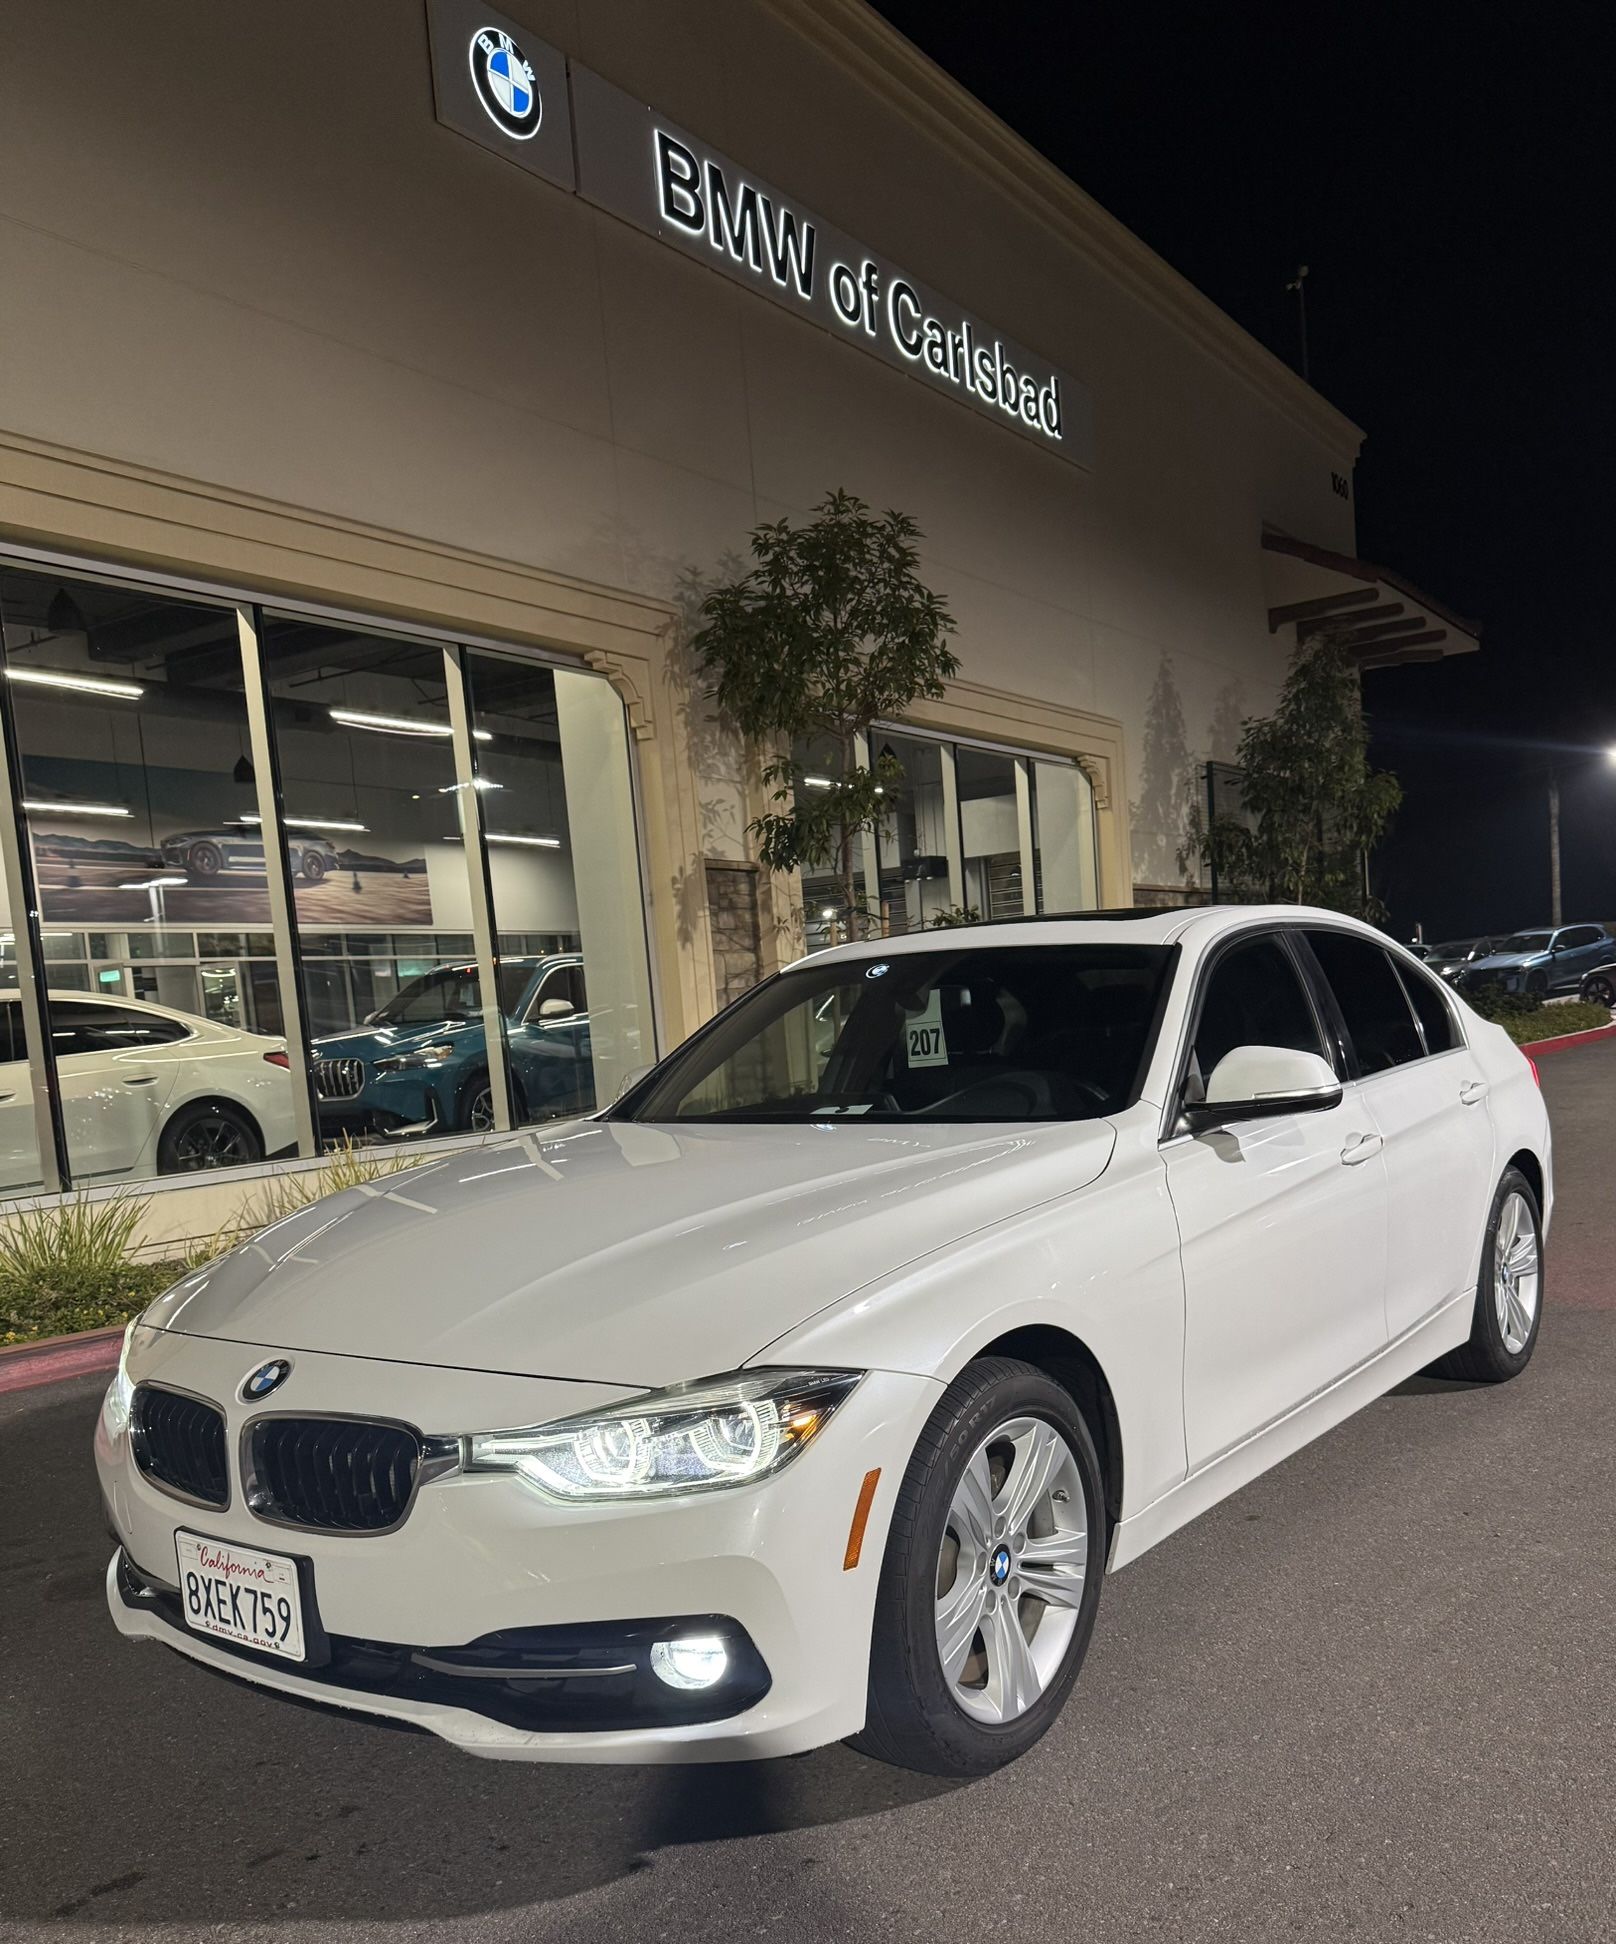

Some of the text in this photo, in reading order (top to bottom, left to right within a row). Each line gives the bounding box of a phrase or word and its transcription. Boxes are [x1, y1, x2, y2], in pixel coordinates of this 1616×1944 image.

[477, 32, 536, 81] BMW
[653, 127, 1063, 440] BMW of Carlsbad
[1330, 471, 1349, 500] 1060
[909, 1027, 940, 1056] 207
[200, 1545, 274, 1584] California
[186, 1571, 292, 1642] 8XEK759
